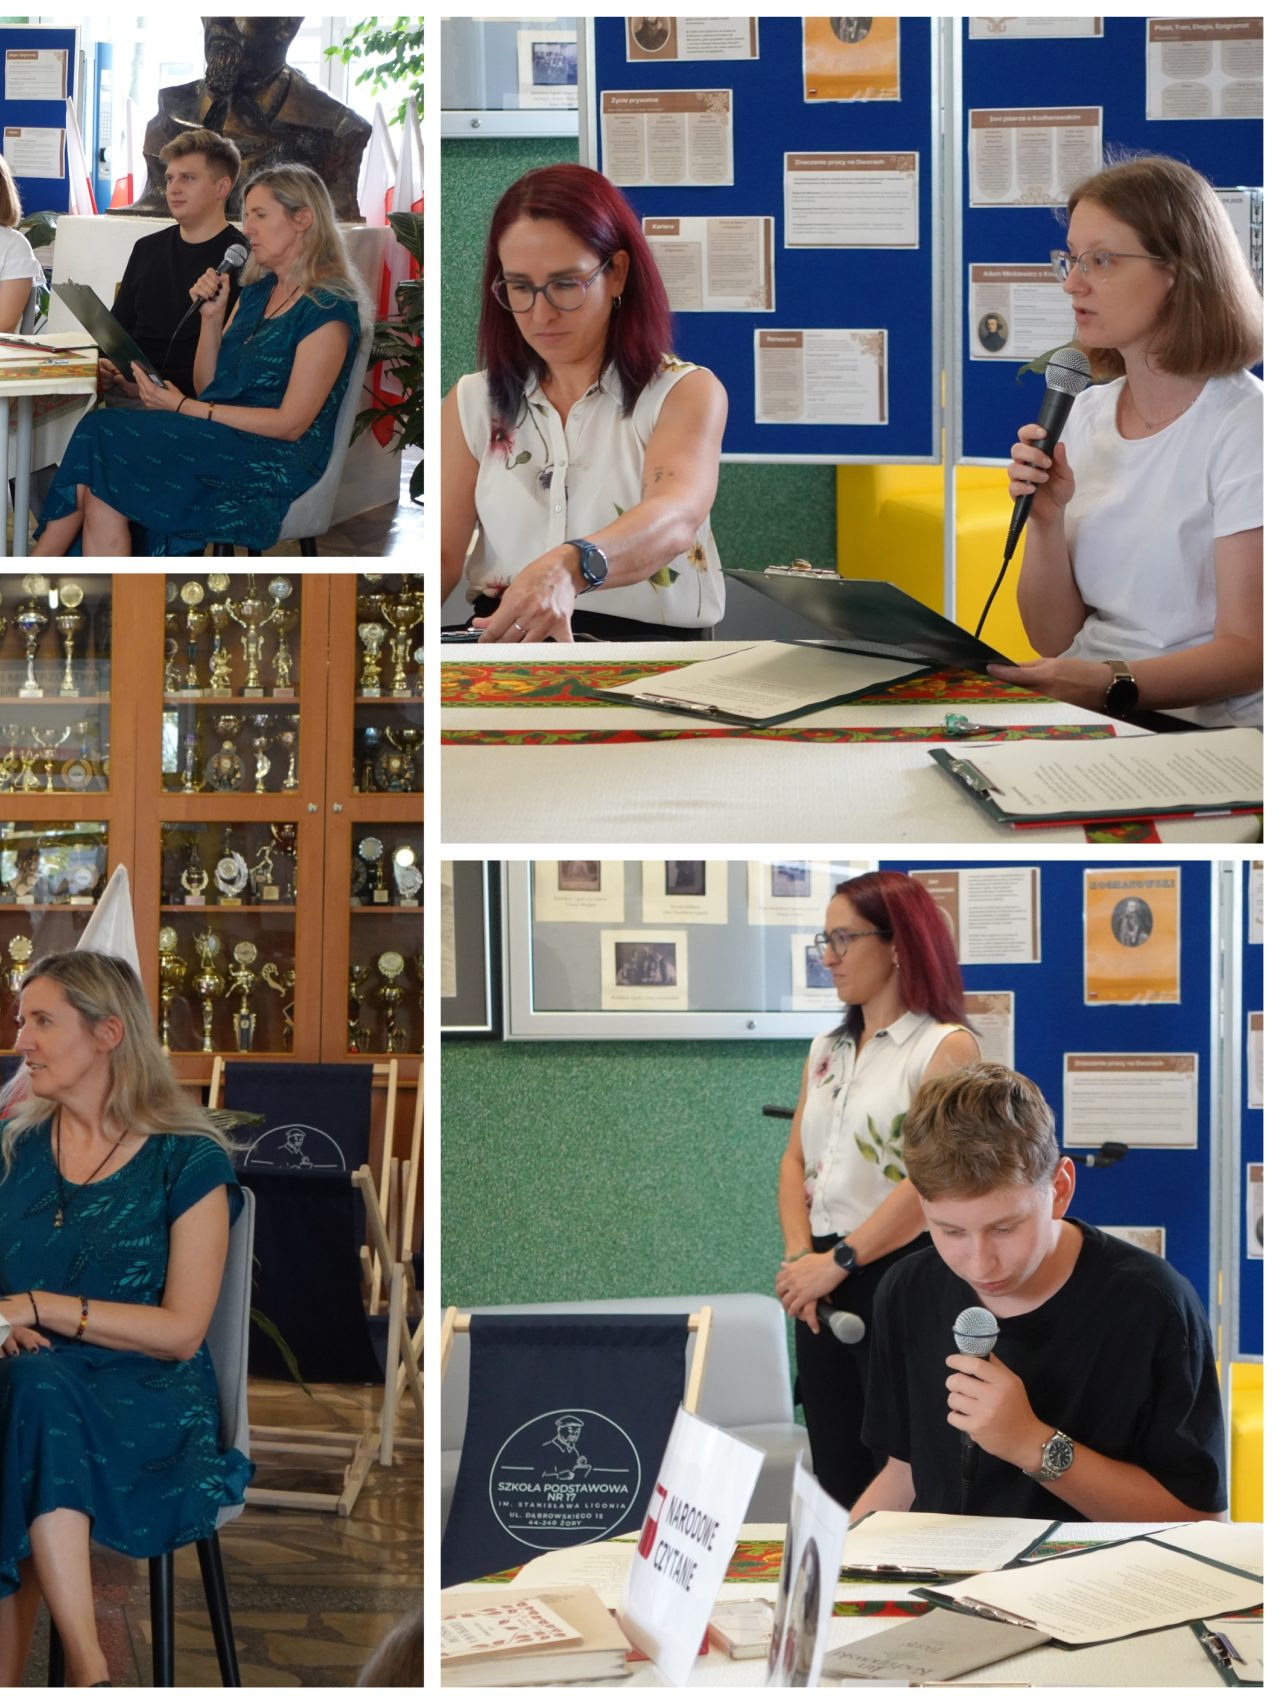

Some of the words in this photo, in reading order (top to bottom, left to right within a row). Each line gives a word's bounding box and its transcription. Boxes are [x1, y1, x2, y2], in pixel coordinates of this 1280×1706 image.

[498, 1481, 542, 1493] SZKOŁA
[543, 1483, 629, 1494] PODSTAWOWA
[547, 1493, 564, 1502] NR
[566, 1493, 577, 1502] 17
[518, 1501, 580, 1510] STANISŁAWA
[584, 1502, 627, 1510] LIGONIA
[509, 1511, 522, 1519] UL.
[525, 1511, 593, 1520] DĄBROWSKIEGO
[528, 1519, 557, 1527] 44-240
[666, 1495, 720, 1552] NARODOWE
[653, 1539, 698, 1592] CZYTANIE
